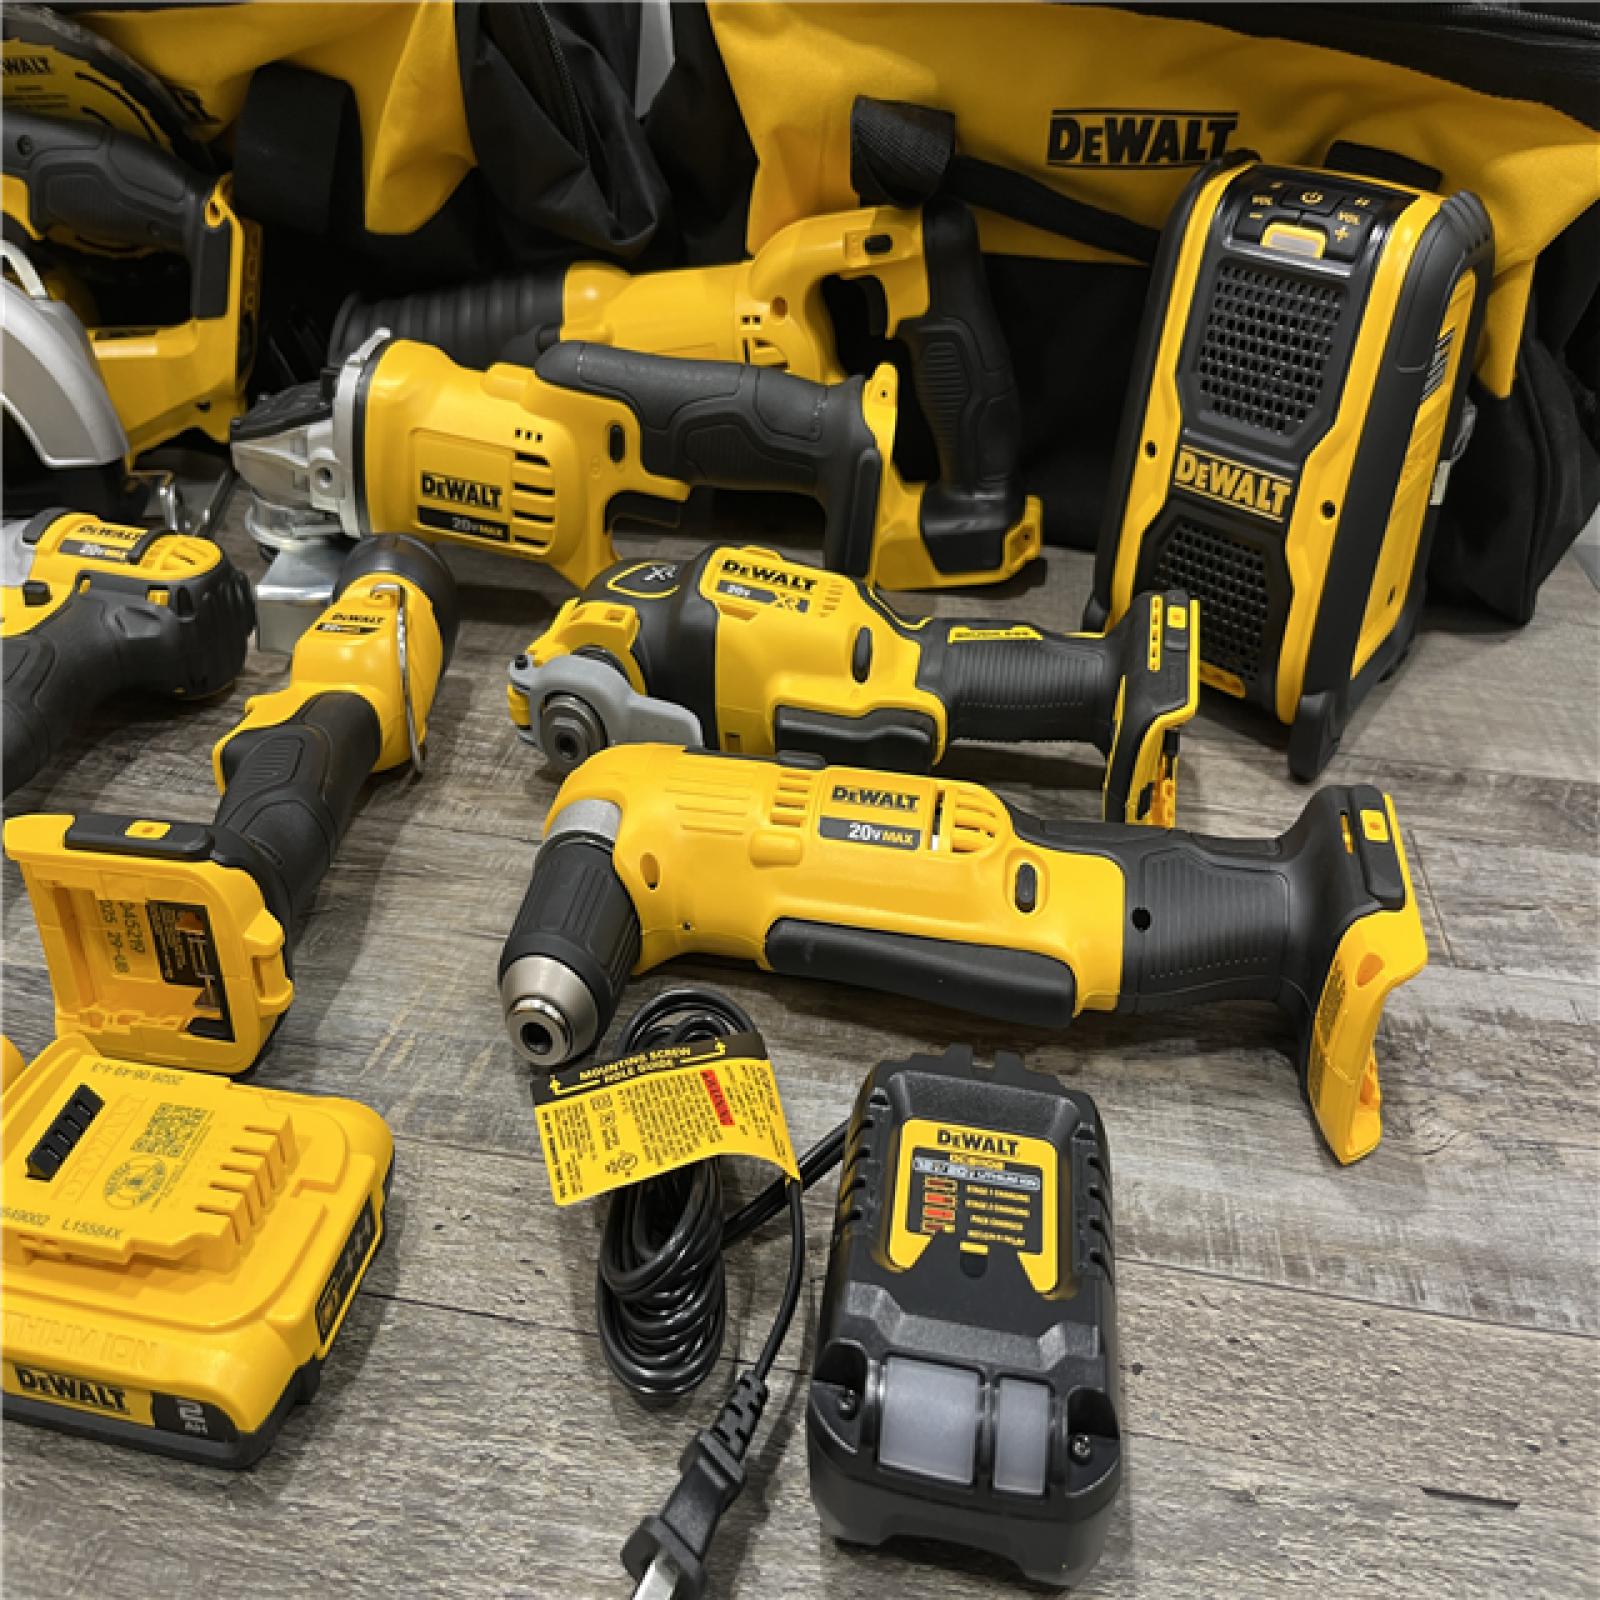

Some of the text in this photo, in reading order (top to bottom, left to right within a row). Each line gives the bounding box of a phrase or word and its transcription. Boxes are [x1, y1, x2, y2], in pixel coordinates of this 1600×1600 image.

[1048, 112, 1238, 165] DEWALT
[420, 471, 503, 511] DEWALT
[1174, 450, 1292, 517] DEWALT
[721, 558, 817, 591] DEWALT
[832, 784, 921, 813] DEWALT
[936, 1128, 1019, 1157] DEWALT
[16, 1367, 126, 1414] DEWALT
